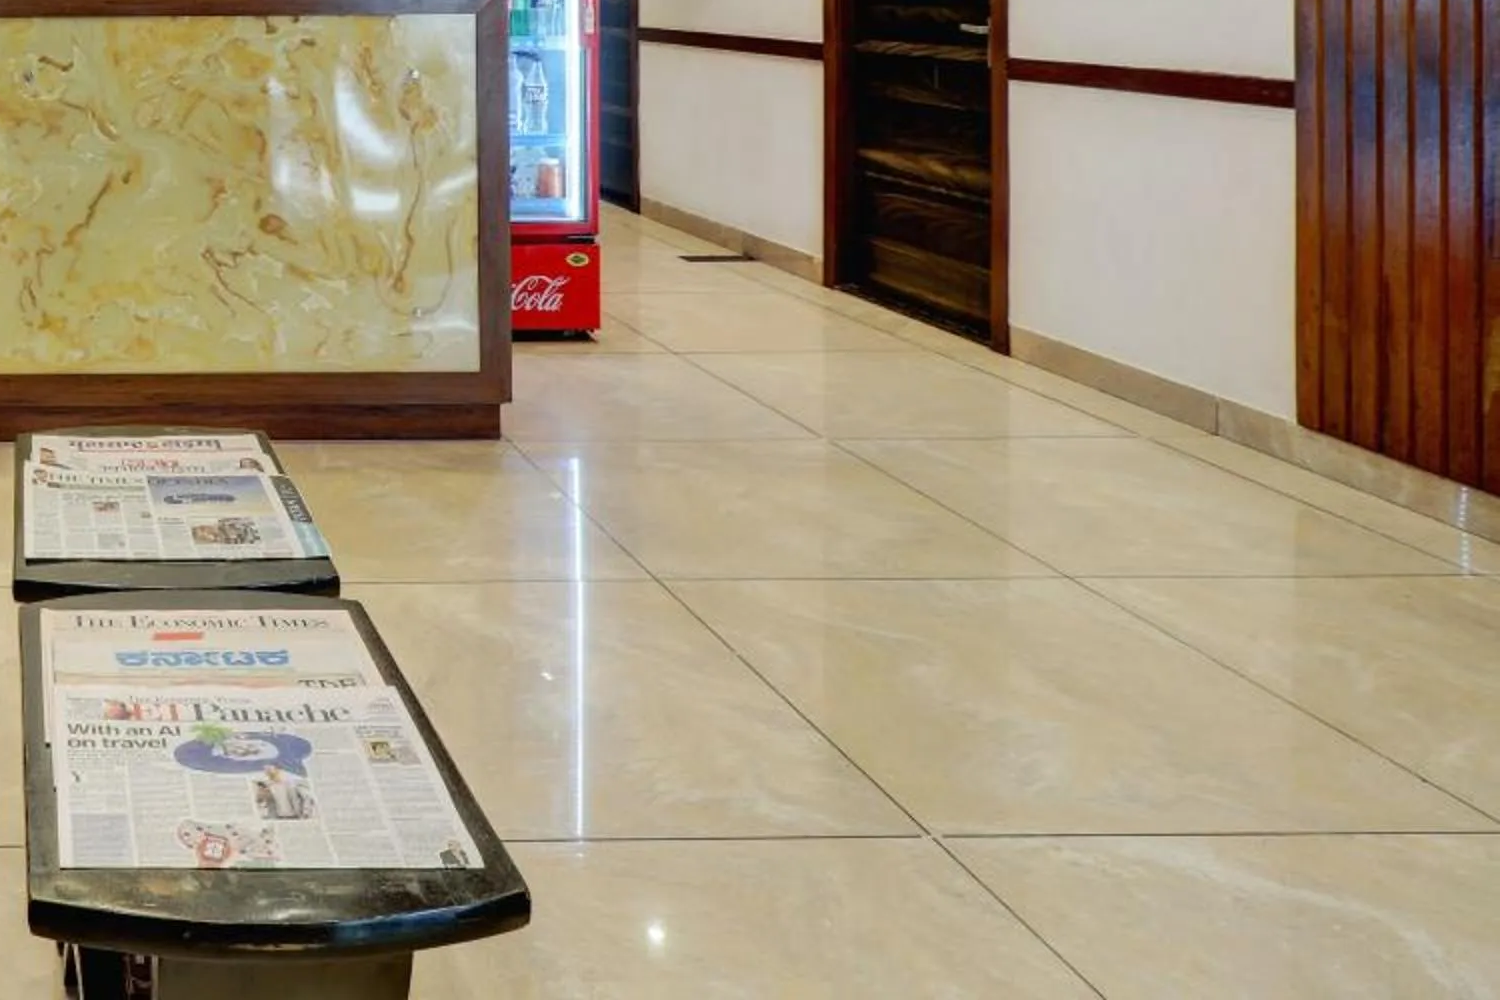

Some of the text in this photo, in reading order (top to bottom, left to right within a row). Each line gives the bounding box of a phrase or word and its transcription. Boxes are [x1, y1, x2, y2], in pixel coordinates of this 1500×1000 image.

[126, 615, 246, 630] ECONOMIC
[255, 615, 329, 629] TIMES
[192, 702, 351, 723] Panache
[67, 723, 120, 737] With
[123, 727, 156, 737] an
[67, 737, 167, 749] on travel
